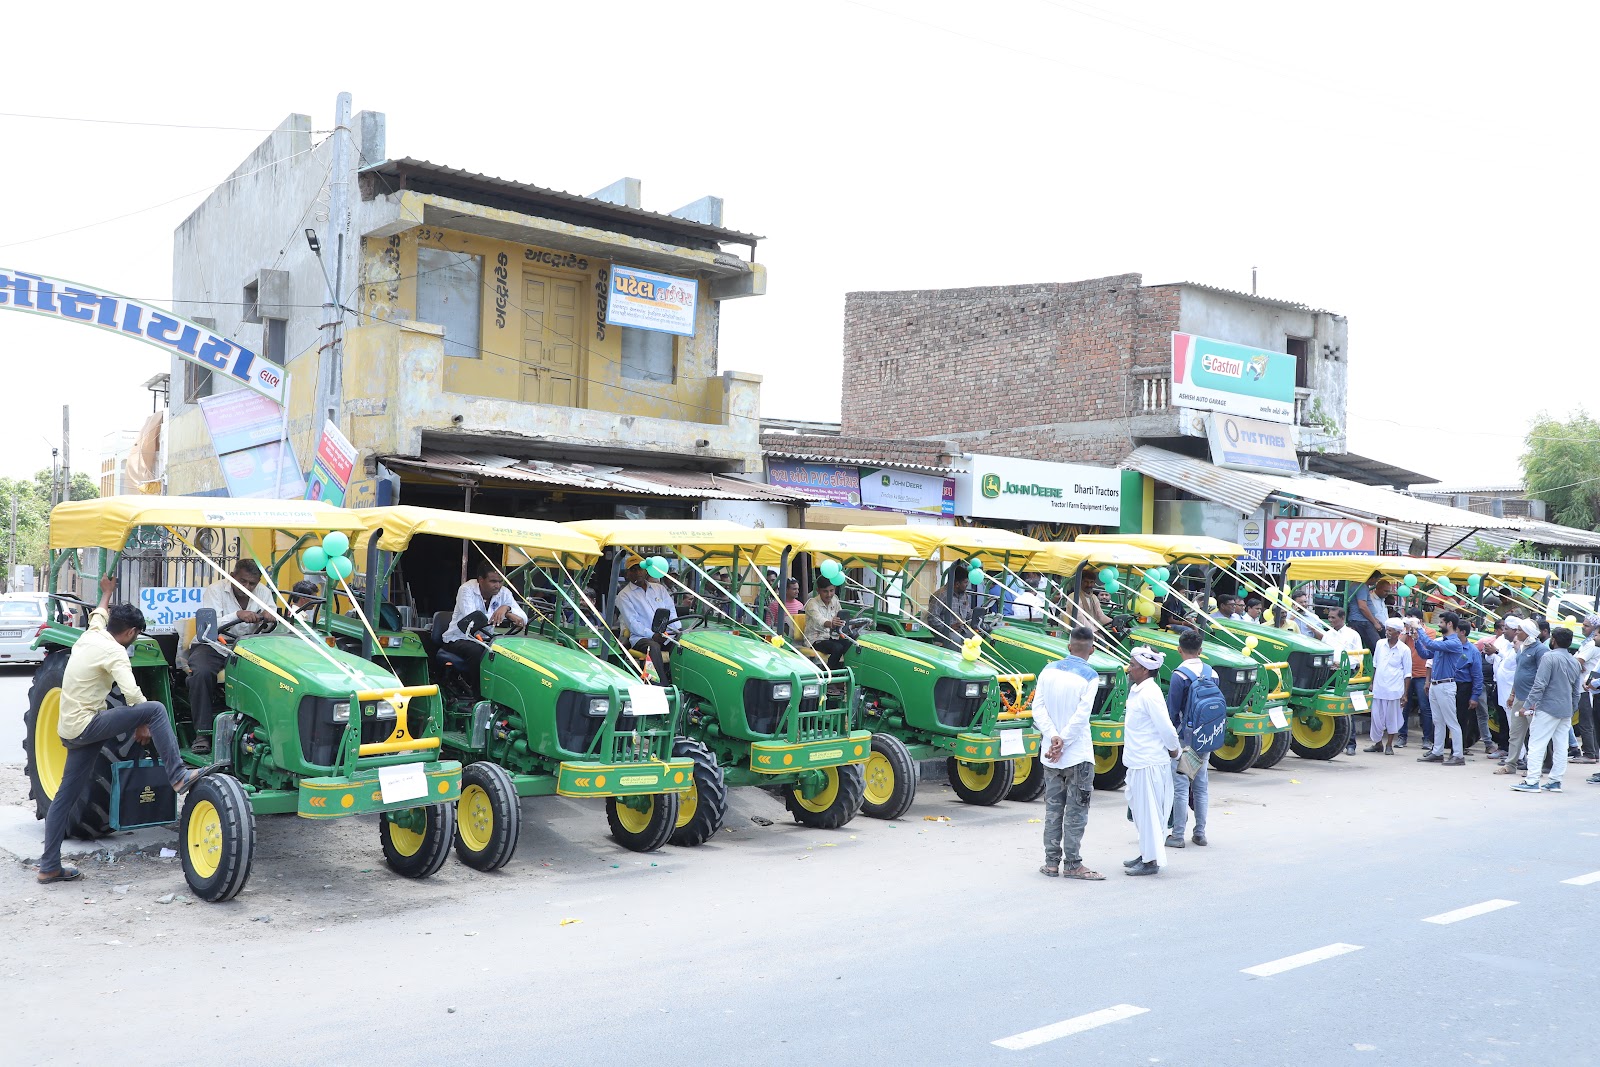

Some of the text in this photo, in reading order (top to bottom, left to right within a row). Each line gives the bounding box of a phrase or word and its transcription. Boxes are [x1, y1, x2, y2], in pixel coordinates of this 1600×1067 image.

[614, 275, 656, 301] પટેલ
[1212, 358, 1240, 375] Castrol
[1179, 393, 1227, 406] ASHISH AUTO GARAGE
[1241, 430, 1286, 448] TVS TYRES
[810, 471, 829, 485] PVC
[905, 481, 922, 489] DEERE
[1002, 481, 1063, 498] JOHN DEERE
[1074, 484, 1119, 497] Dharti Tractors
[1080, 503, 1102, 511] Equipment
[1271, 521, 1364, 549] SERVO
[1243, 549, 1306, 560] WORD-CLASS
